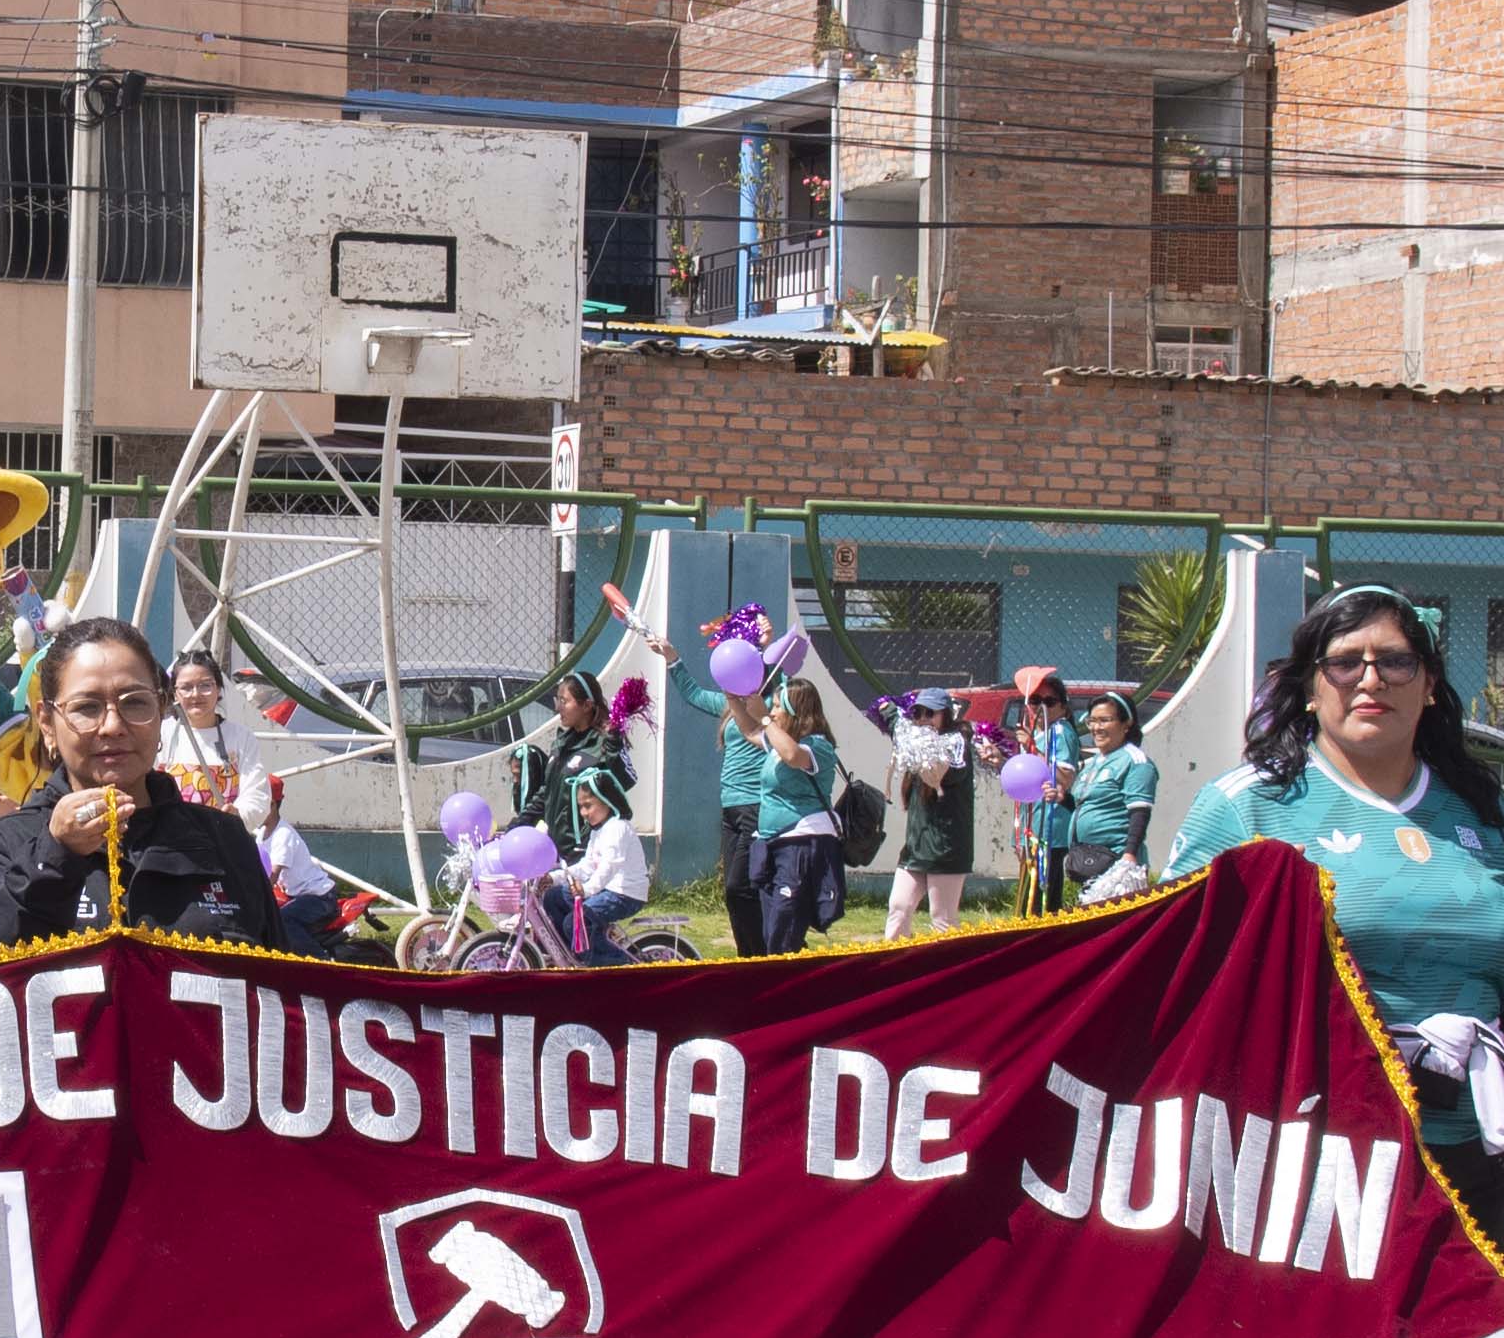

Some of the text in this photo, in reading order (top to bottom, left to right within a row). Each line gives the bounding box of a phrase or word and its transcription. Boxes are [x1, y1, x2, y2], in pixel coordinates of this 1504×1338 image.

[558, 452, 571, 490] 30
[169, 971, 746, 1177] JUSTICIA
[807, 1046, 982, 1183] DE
[1021, 1063, 1402, 1281] JUNÍN
